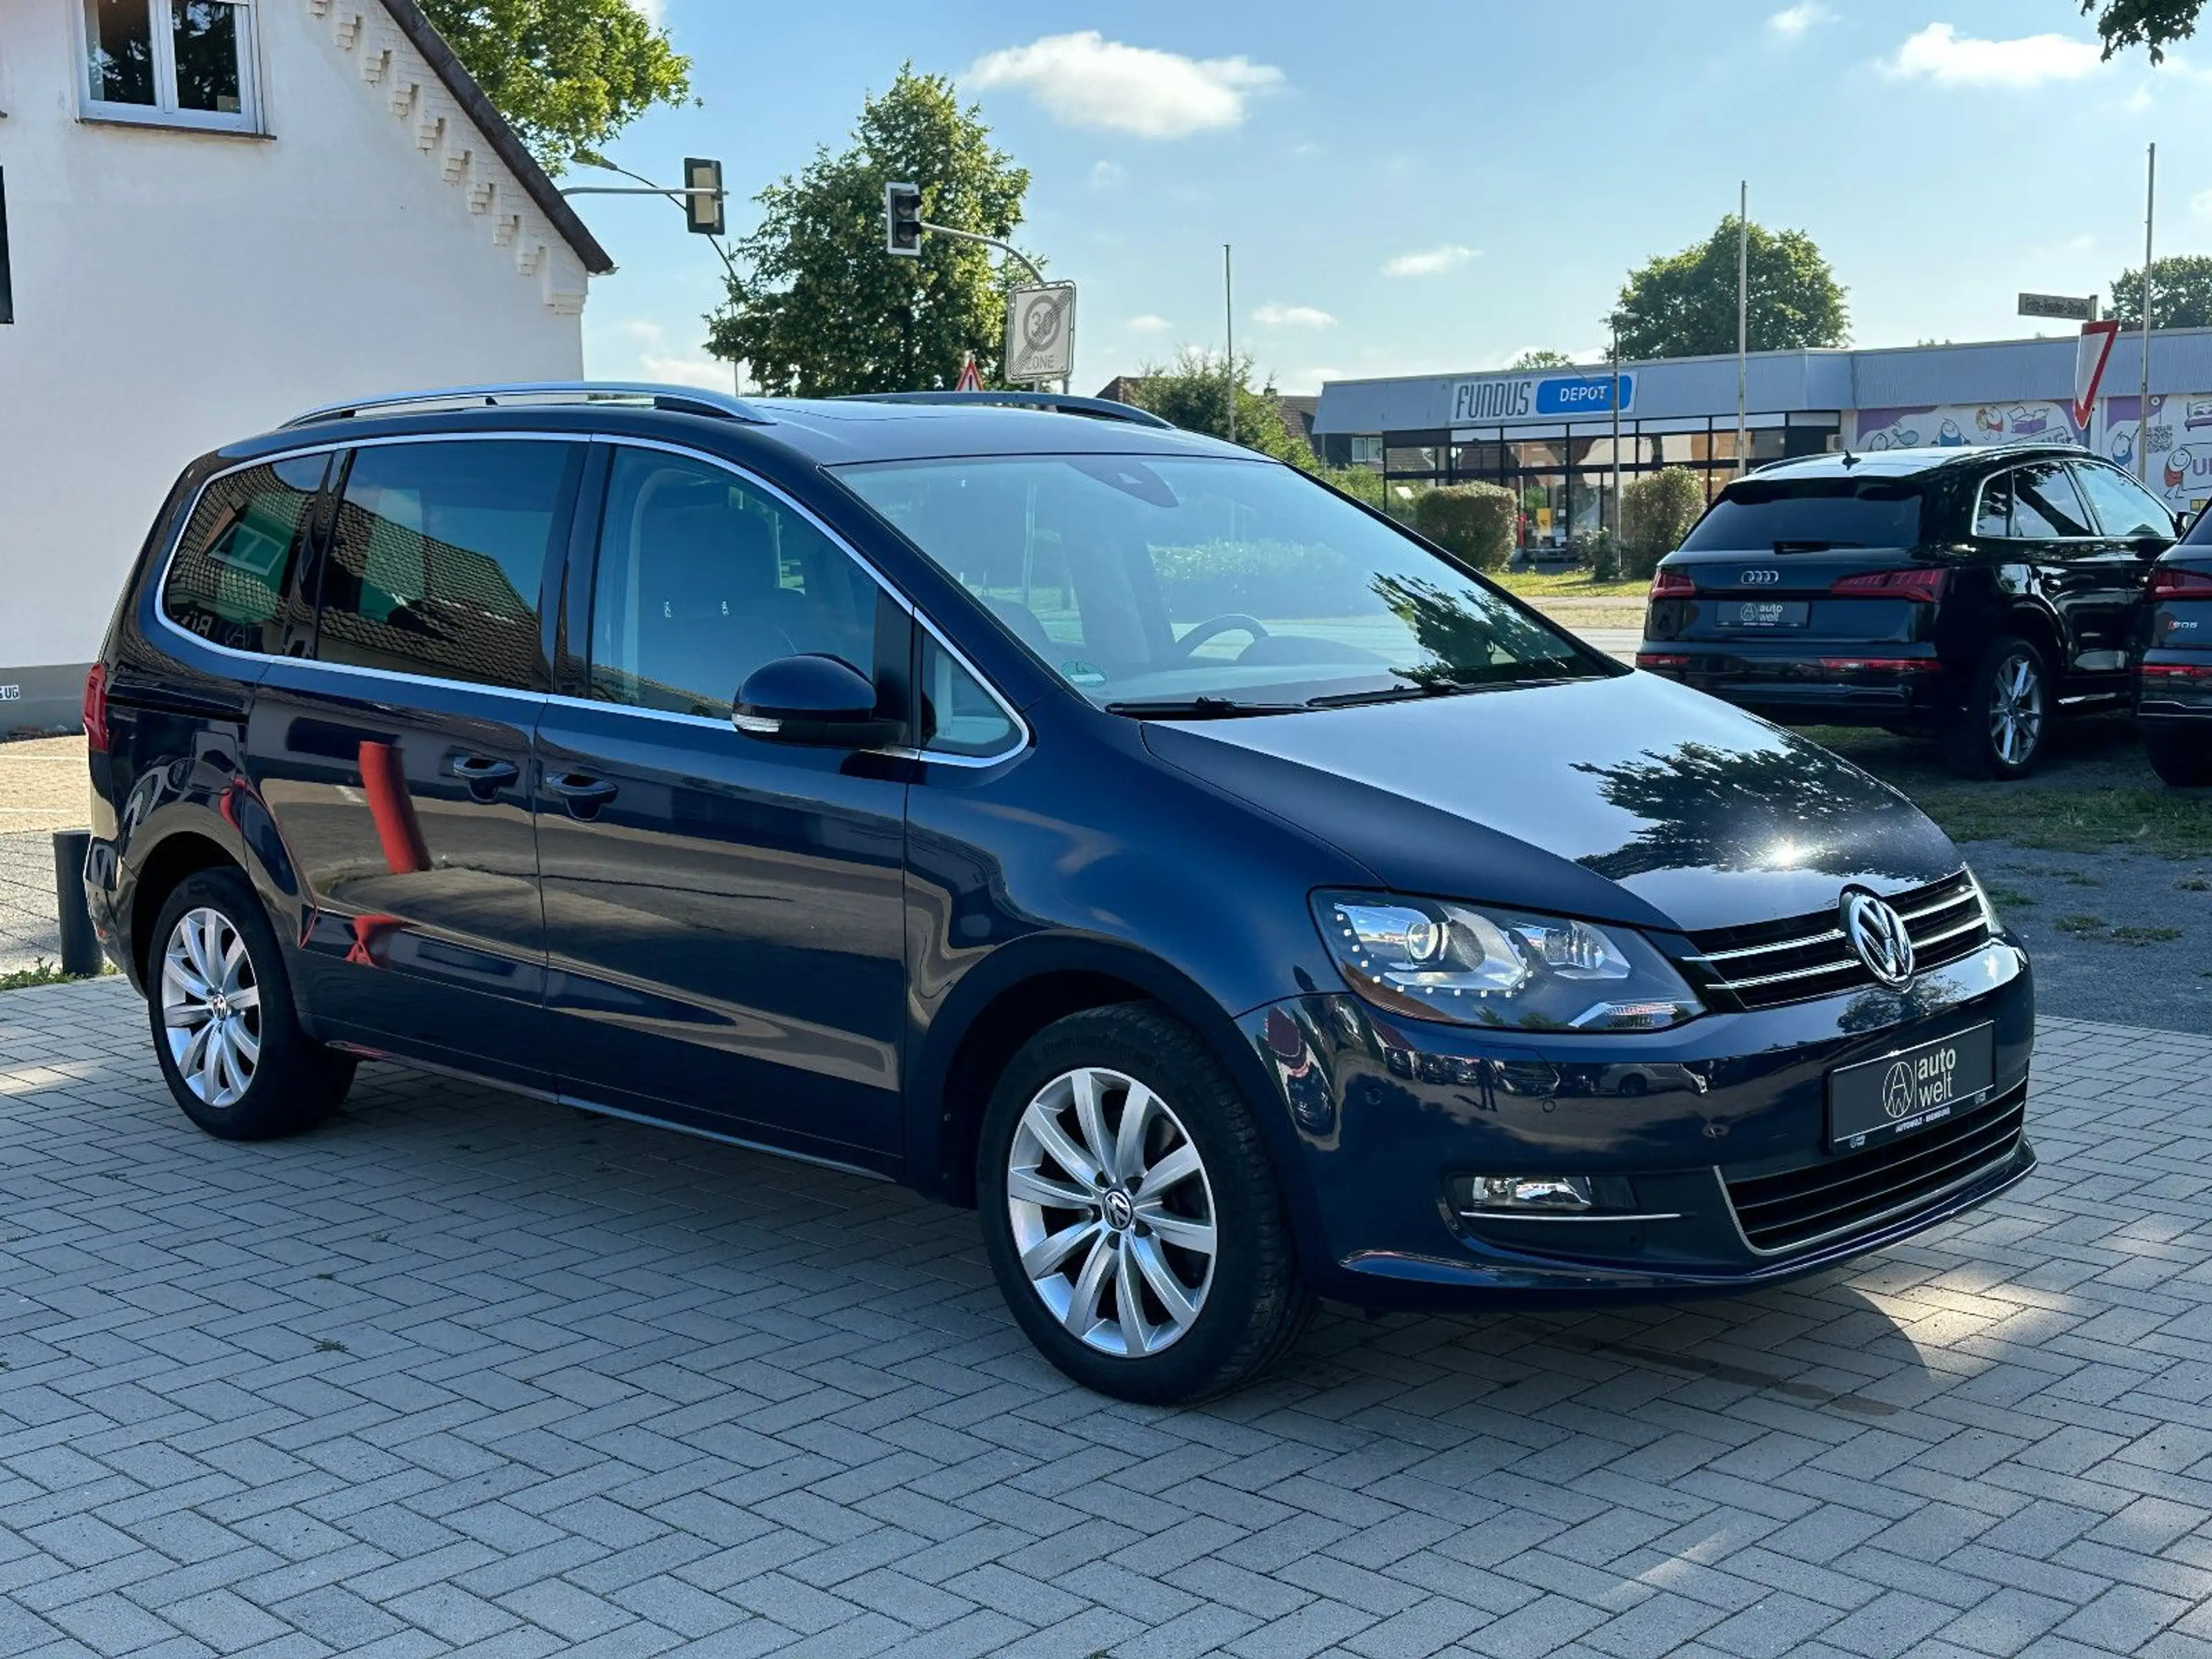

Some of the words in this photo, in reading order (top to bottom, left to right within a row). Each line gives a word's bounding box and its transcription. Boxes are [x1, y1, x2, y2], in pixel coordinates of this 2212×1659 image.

[1456, 381, 1531, 419] FUNDUS
[1559, 385, 1607, 402] DEPOT
[1760, 604, 1783, 612] auto
[1918, 1048, 1956, 1080] auto
[1919, 1071, 1953, 1107] welt
